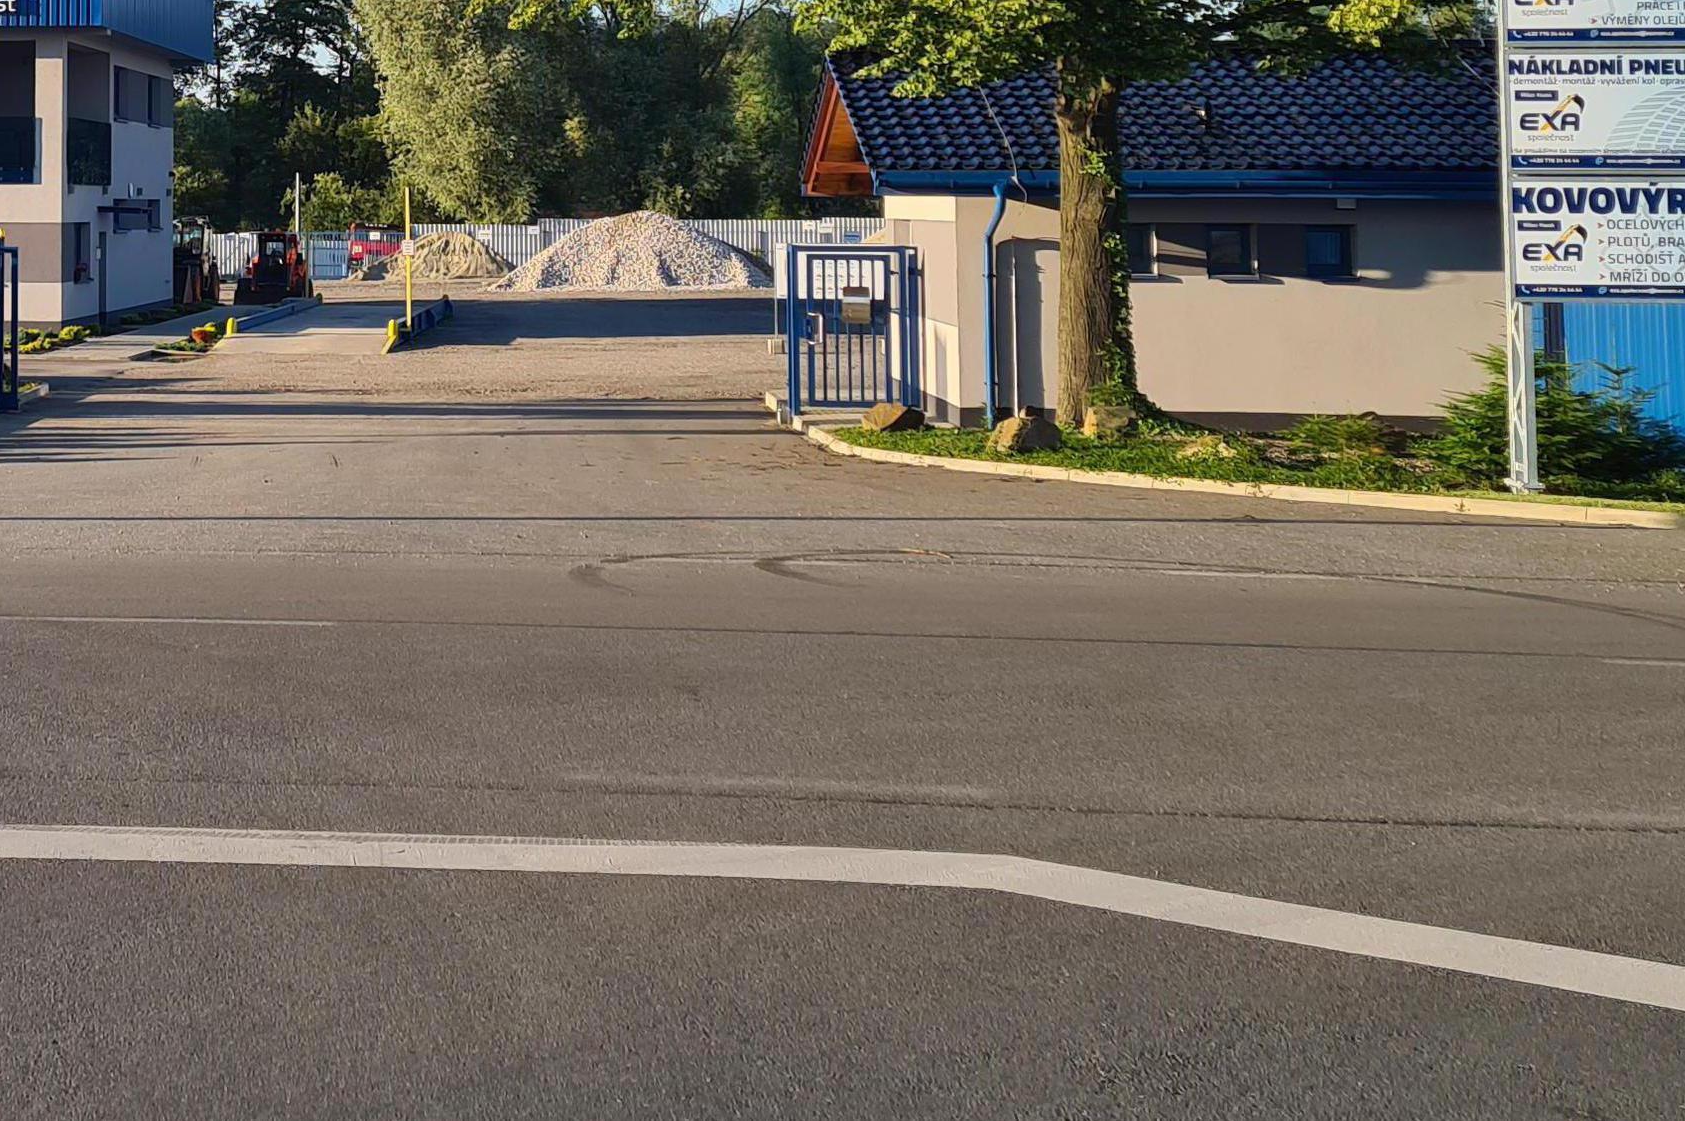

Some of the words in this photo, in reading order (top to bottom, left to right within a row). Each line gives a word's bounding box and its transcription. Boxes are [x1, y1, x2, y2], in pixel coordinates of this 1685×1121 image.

[1602, 12, 1651, 26] VÝMĚNY
[1508, 55, 1624, 76] NÁKLADNÍ
[1629, 59, 1685, 76] PNEU
[1513, 77, 1558, 86] demontáž
[1562, 77, 1596, 86] montáž
[1600, 77, 1640, 87] vyvážení
[1642, 77, 1656, 86] kol
[1519, 110, 1581, 132] EXA
[1512, 182, 1685, 215] KOVOVÝR
[1606, 216, 1685, 230] OCELOVÝCH
[1607, 232, 1655, 249] PLOTŮ,
[1522, 240, 1584, 262] EXA
[1607, 250, 1675, 265] SCHODIŠŤ
[1610, 267, 1649, 283] MŘÍŽÍ
[1652, 271, 1672, 283] DO
[1674, 271, 1685, 283] O
